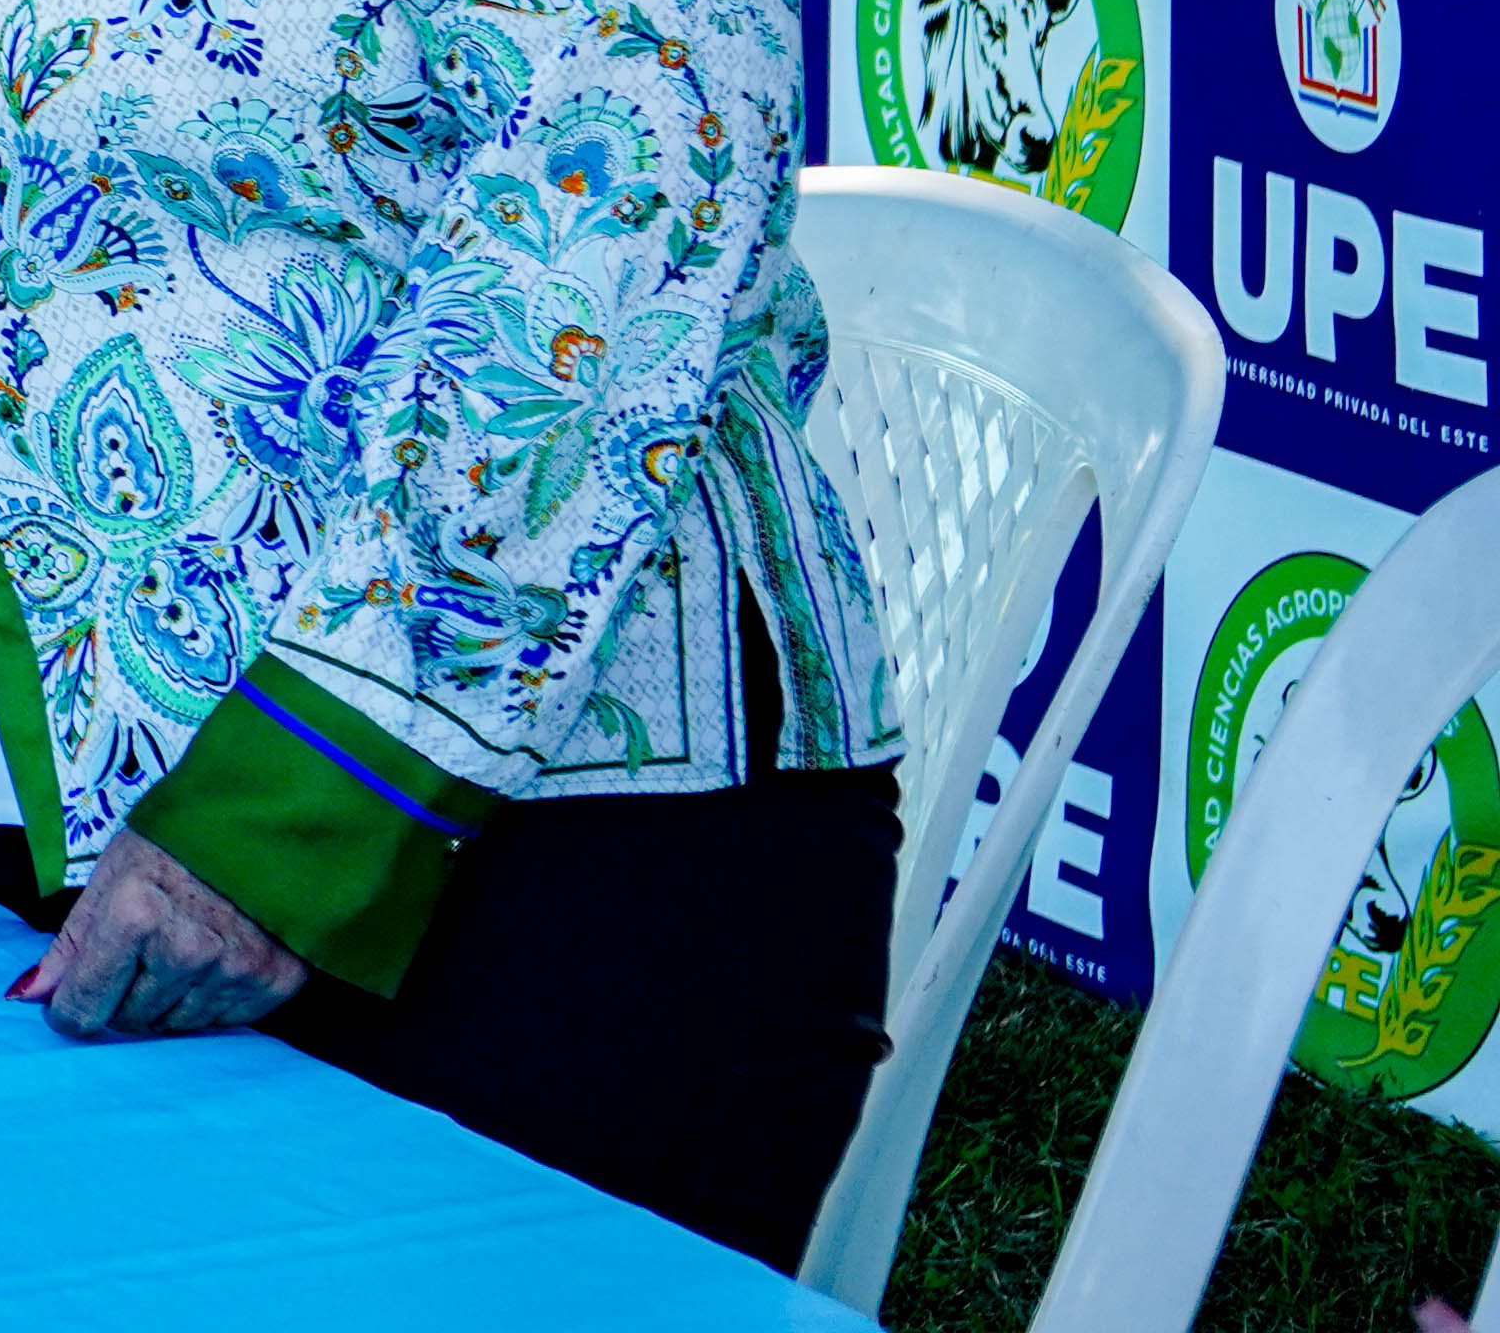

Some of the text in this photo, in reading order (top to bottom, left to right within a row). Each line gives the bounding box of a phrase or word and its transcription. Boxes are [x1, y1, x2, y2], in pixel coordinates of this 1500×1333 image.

[874, 48, 913, 169] ULTAD
[1213, 155, 1489, 407] UPE
[1324, 387, 1390, 426] PRIVADA
[1398, 412, 1430, 438] DEL
[1440, 425, 1489, 453] ESTE
[1206, 623, 1265, 783] CIENCIAS
[1065, 952, 1107, 983] ESTE
